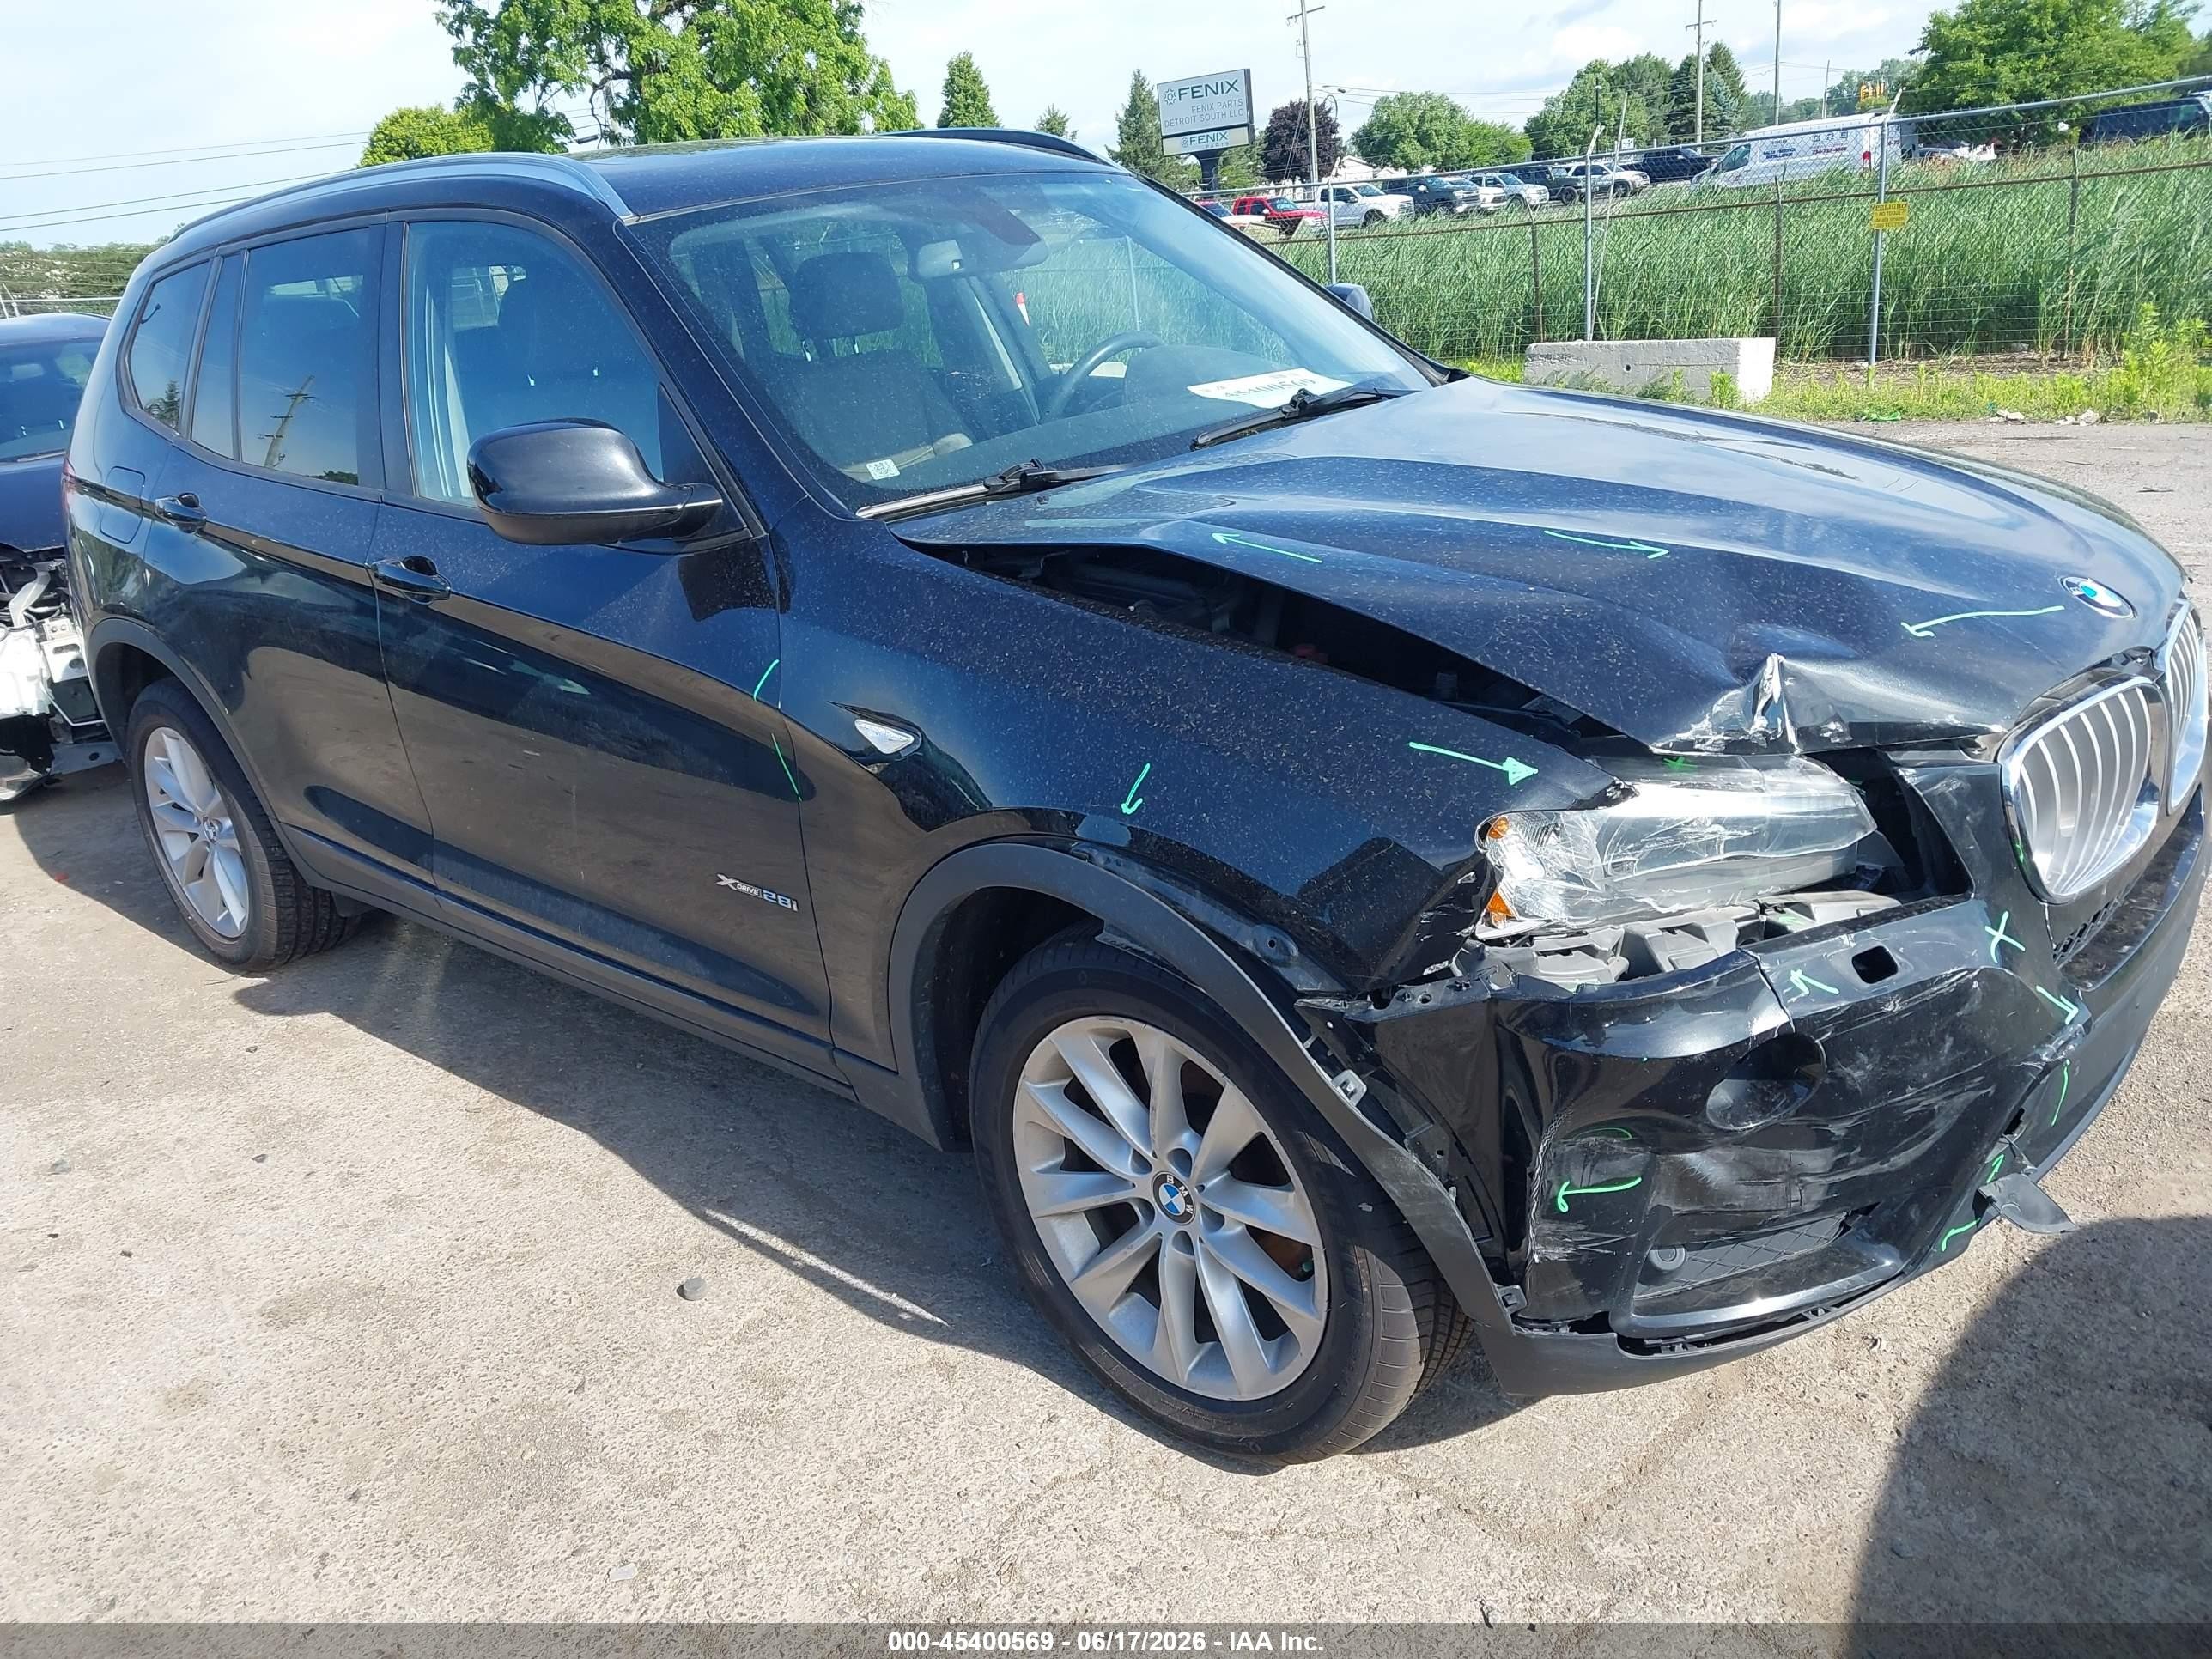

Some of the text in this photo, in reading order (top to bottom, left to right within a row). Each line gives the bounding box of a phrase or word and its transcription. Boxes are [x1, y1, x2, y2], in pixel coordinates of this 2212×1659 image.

[1178, 78, 1239, 101] FENIX
[1191, 98, 1243, 114] FENIX PARTS
[1164, 108, 1244, 128] DETROIT SOUTH LLC
[1189, 131, 1228, 145] FENIX
[1166, 1174, 1194, 1214] BMW
